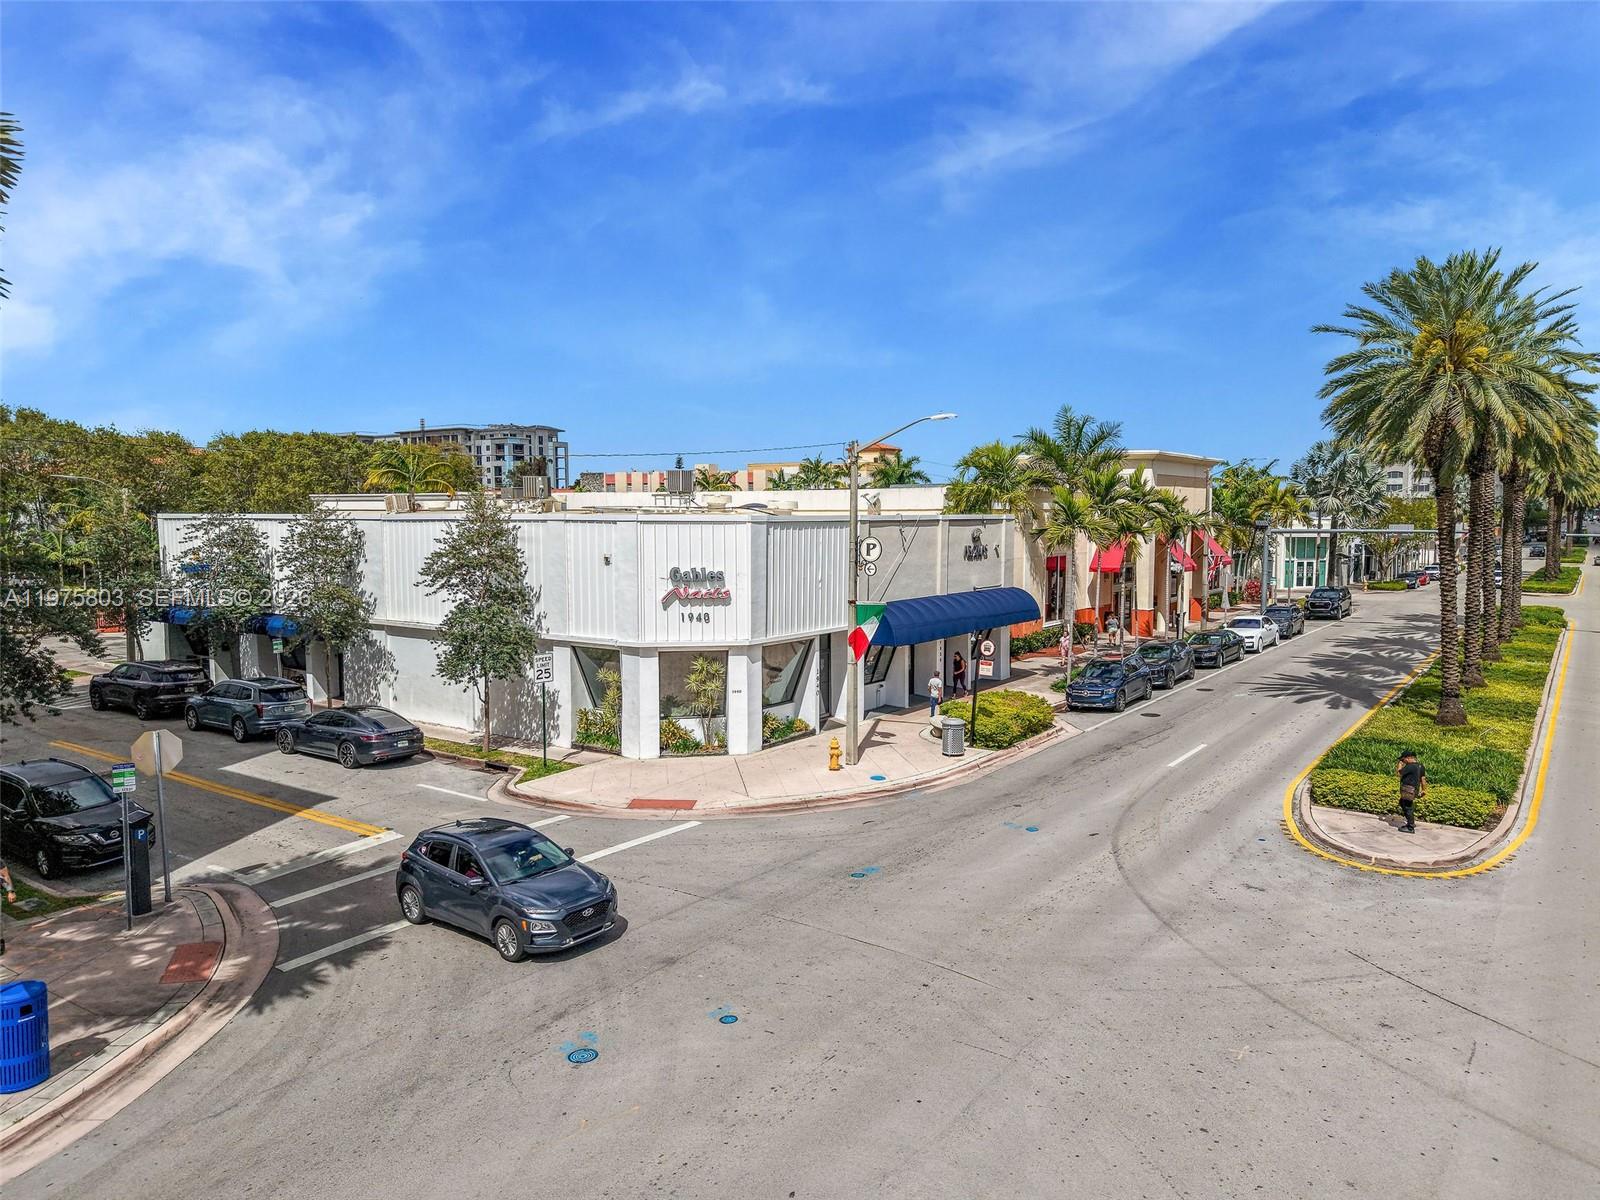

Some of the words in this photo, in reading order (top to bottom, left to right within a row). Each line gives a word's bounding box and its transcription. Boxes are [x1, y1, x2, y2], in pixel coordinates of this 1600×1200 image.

[866, 542, 877, 557] P
[669, 567, 725, 583] Gables
[660, 584, 732, 605] Nails
[536, 668, 552, 680] 25
[138, 829, 145, 840] P
